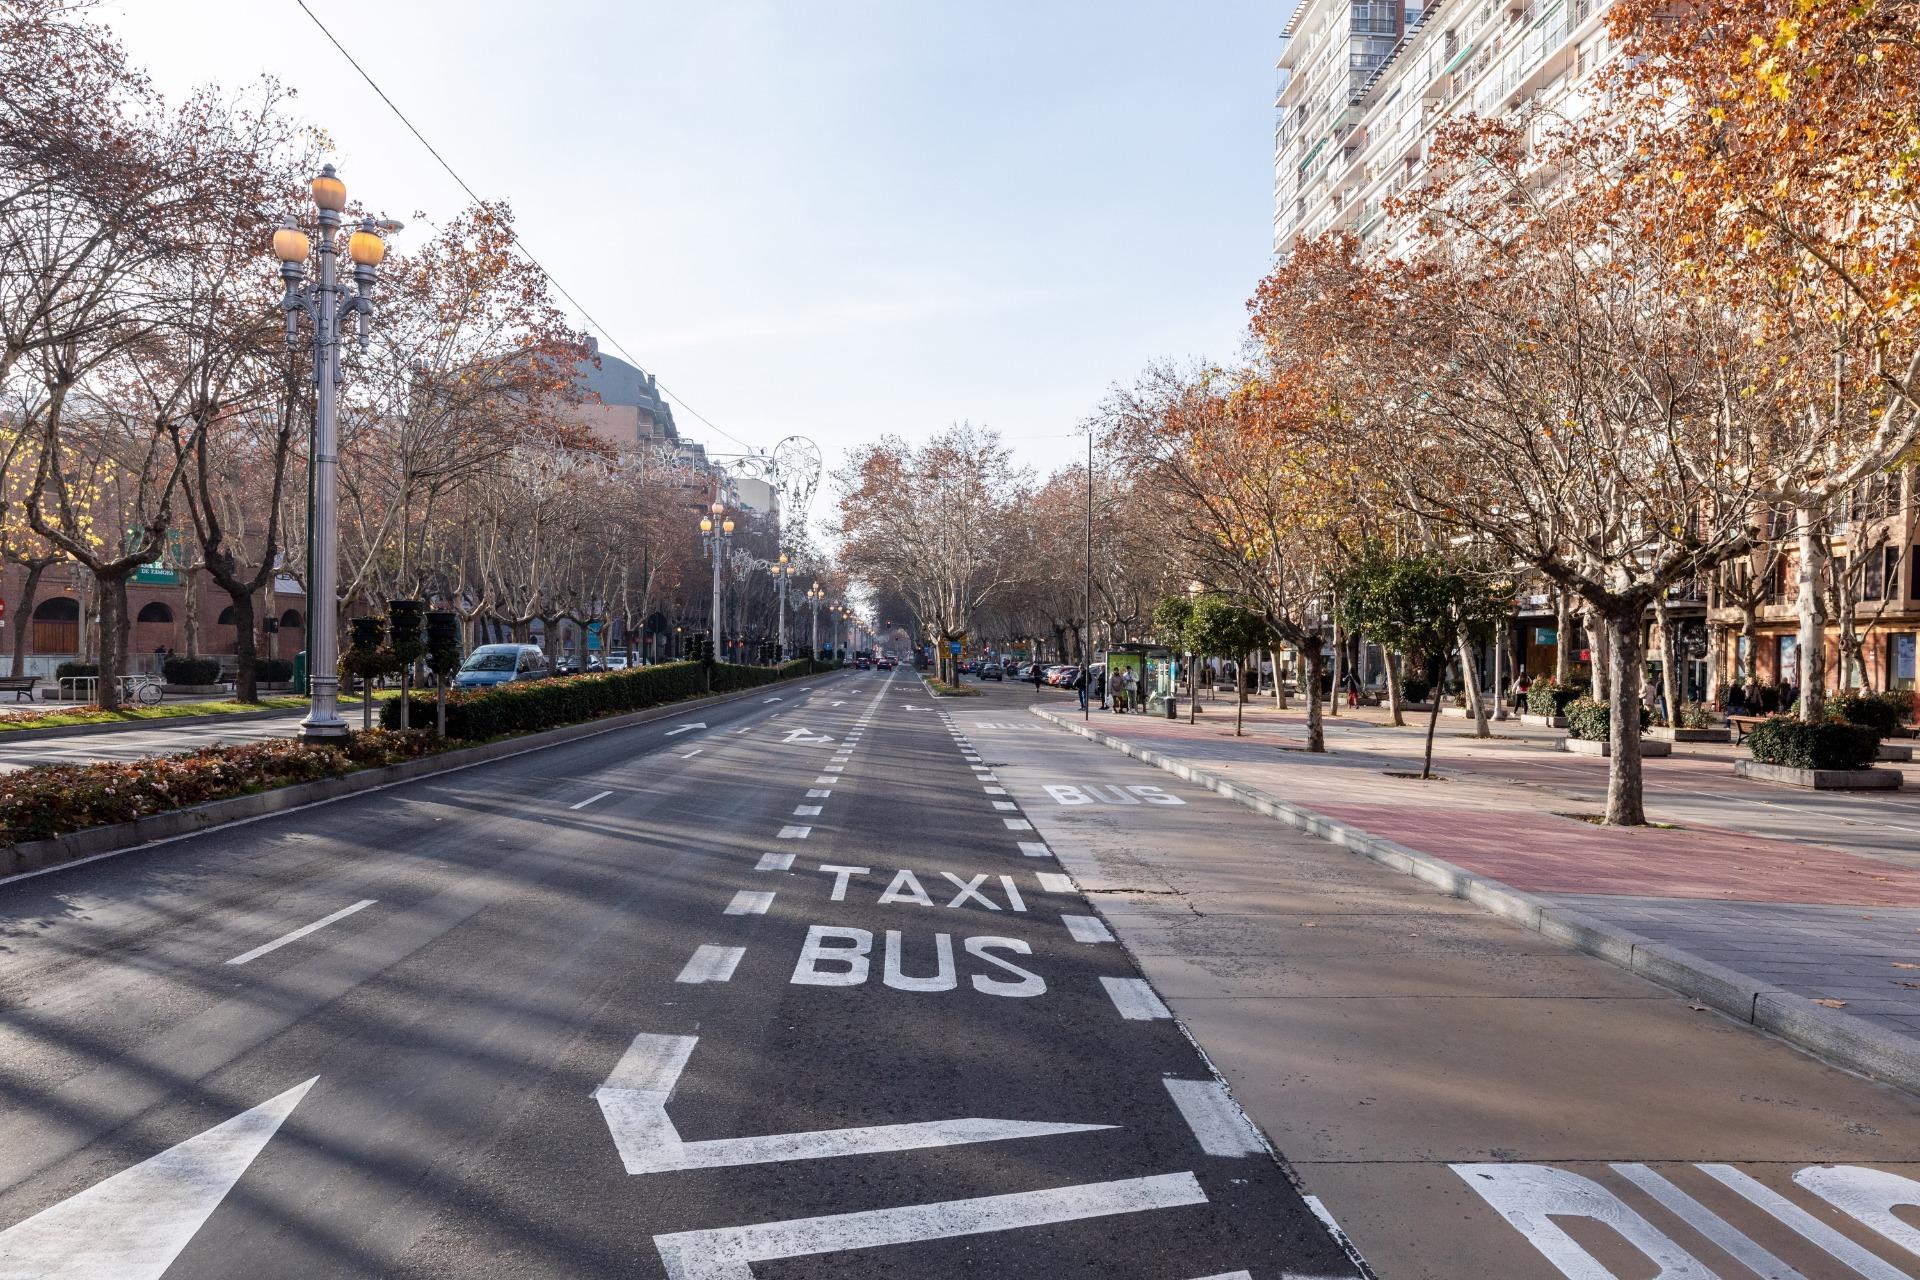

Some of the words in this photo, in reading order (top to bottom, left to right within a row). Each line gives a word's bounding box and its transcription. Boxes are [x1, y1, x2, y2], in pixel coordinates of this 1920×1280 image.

[1042, 785, 1187, 805] BUS
[819, 865, 1027, 911] TAXI
[790, 925, 1047, 997] BUS
